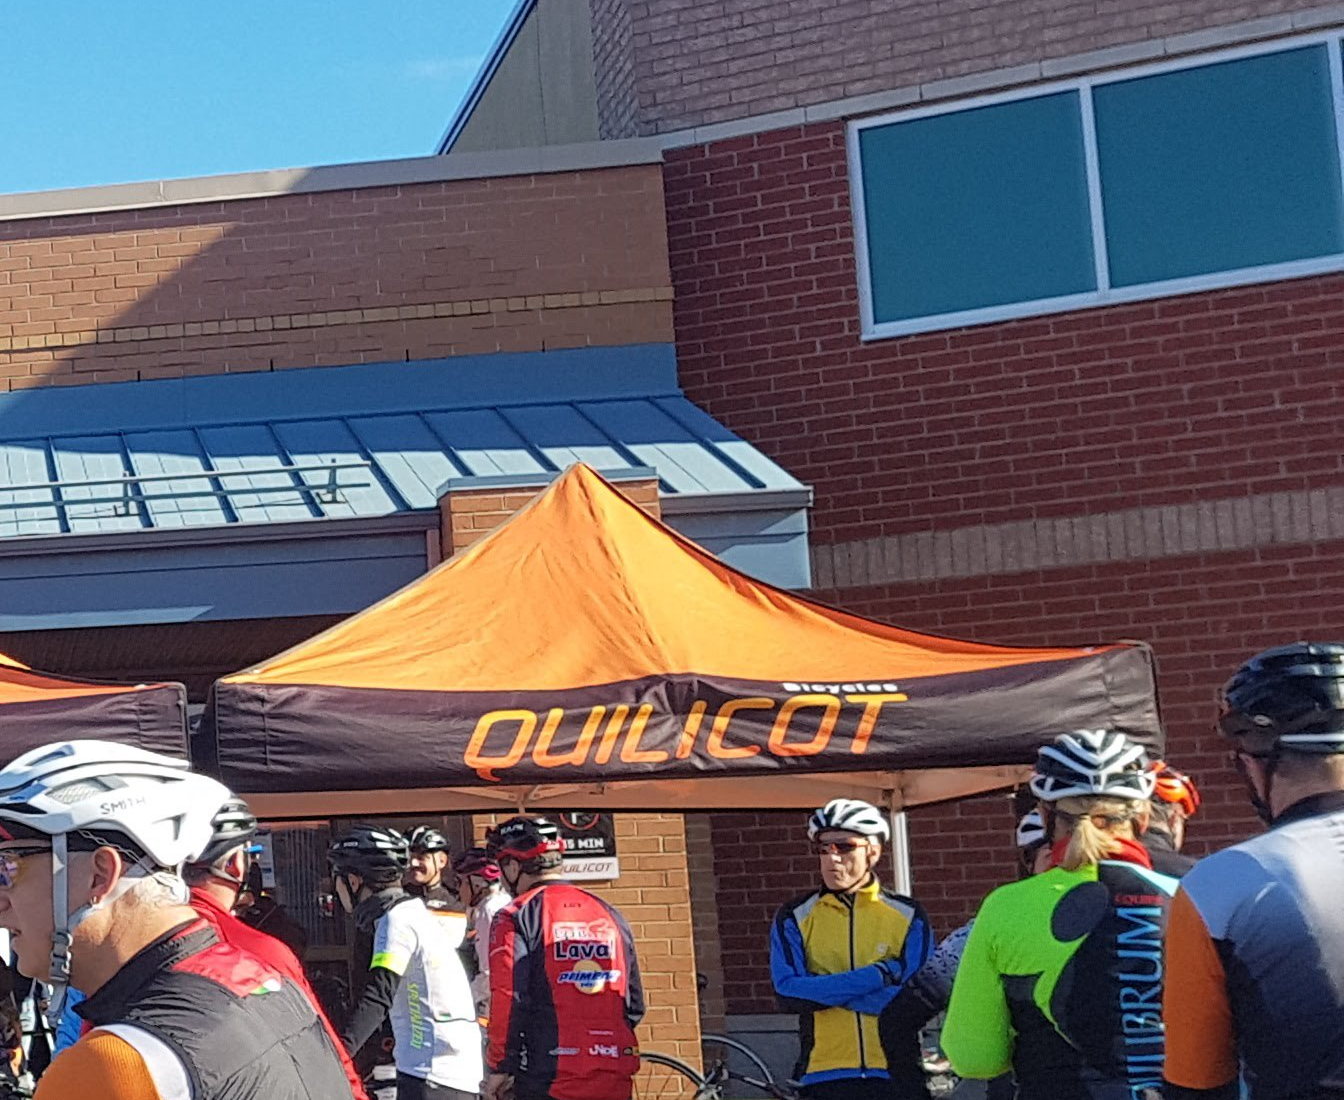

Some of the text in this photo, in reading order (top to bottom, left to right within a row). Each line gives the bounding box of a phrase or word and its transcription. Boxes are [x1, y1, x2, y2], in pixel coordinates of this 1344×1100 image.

[782, 681, 899, 695] Bicycles
[462, 693, 908, 783] QUILICOT
[579, 837, 604, 848] MIN
